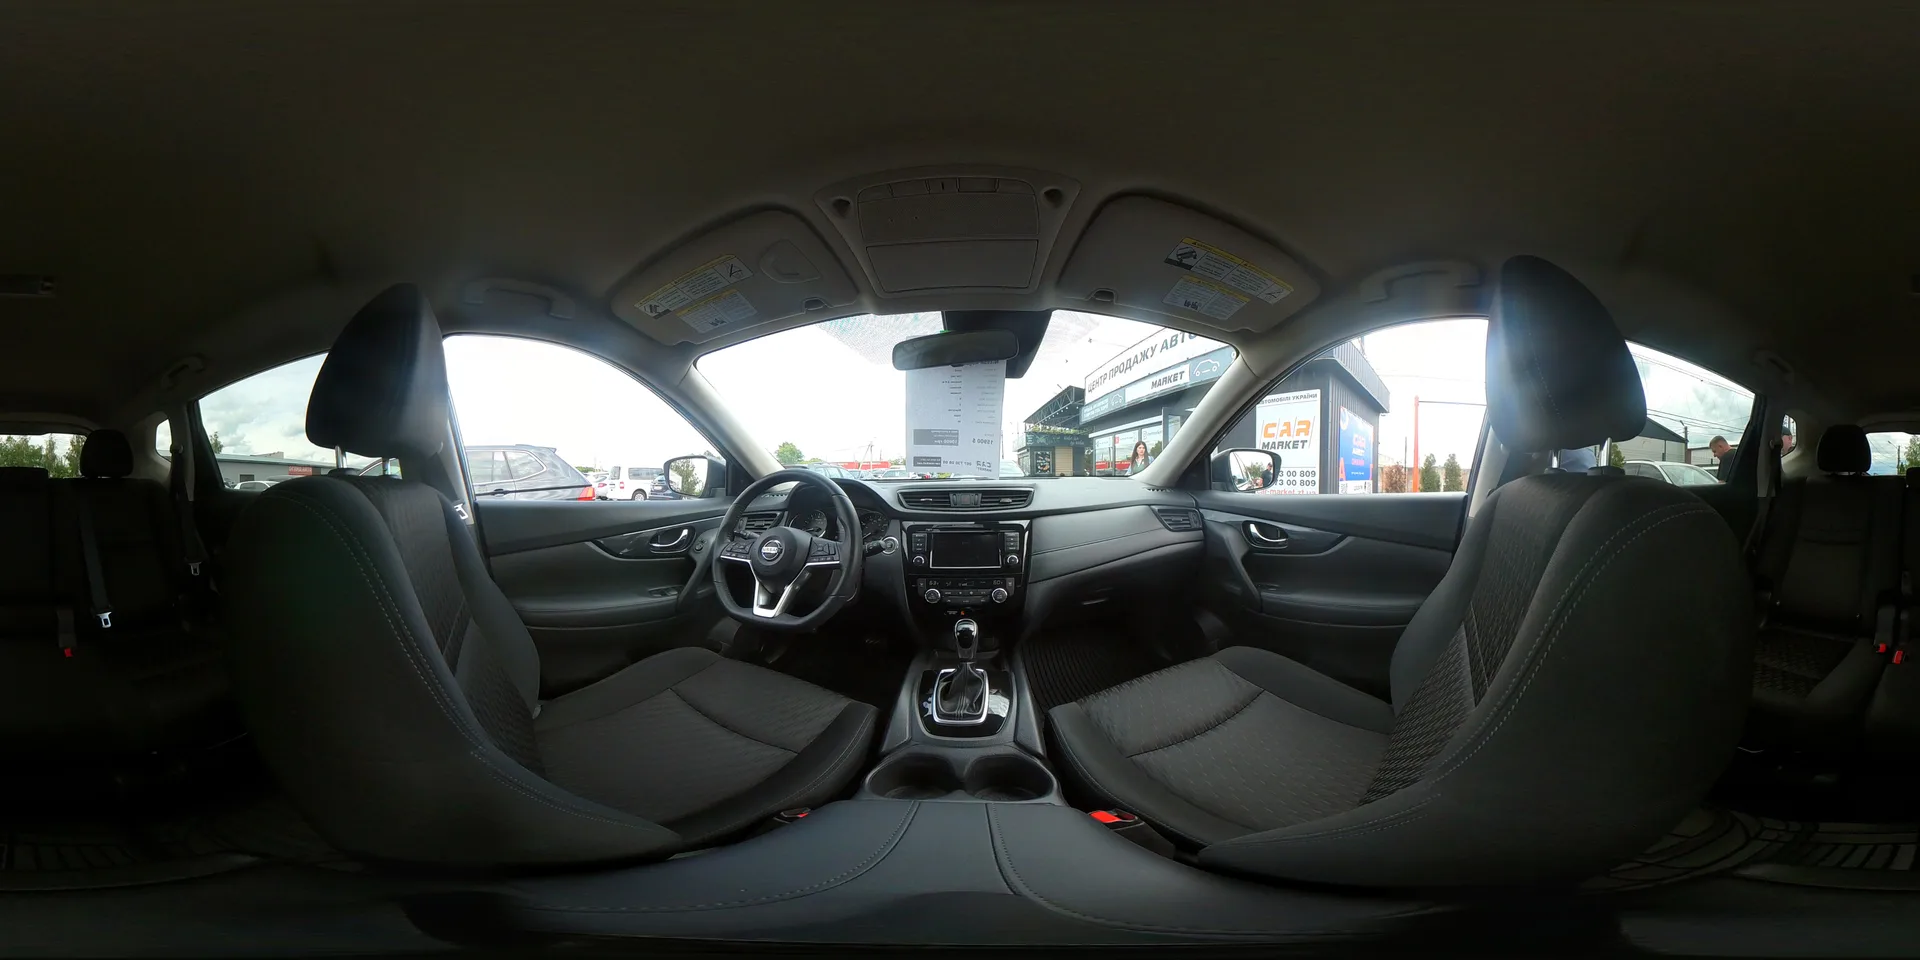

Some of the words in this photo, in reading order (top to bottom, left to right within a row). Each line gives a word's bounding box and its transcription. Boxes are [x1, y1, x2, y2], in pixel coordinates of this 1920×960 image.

[1088, 372, 1108, 393] ЦЕНТР
[1108, 343, 1158, 380] ПРОДАЖУ
[1151, 370, 1185, 389] MARKET
[1292, 392, 1318, 401] УКРАЇНИ
[1263, 420, 1311, 438] CAR
[1261, 440, 1308, 450] MARKET
[1300, 470, 1316, 478] 809
[1300, 479, 1316, 487] 809
